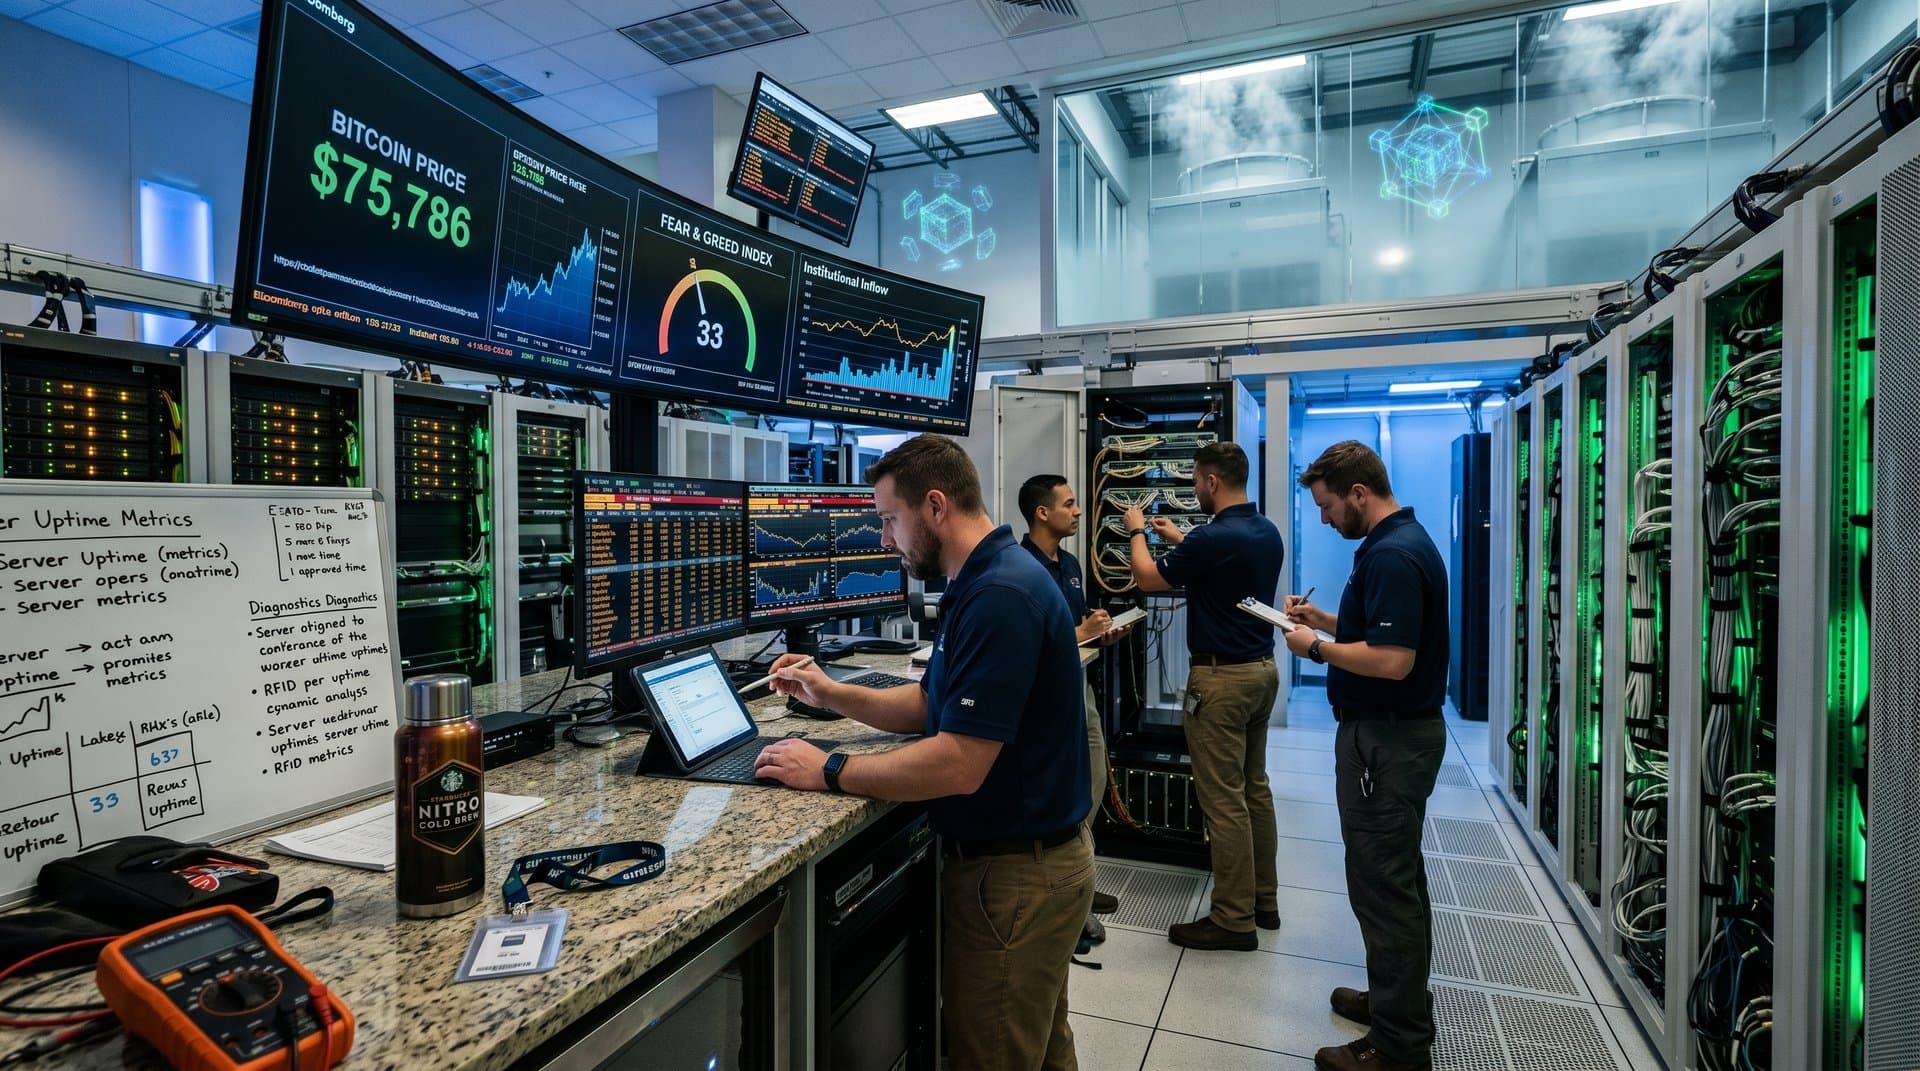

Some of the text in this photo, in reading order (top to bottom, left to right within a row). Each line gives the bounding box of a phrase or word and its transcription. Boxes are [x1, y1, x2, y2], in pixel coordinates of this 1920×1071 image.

[331, 109, 412, 168] BITCOIN
[415, 153, 467, 195] PRICE
[310, 141, 472, 248] $75,786
[660, 213, 773, 267] FEAR & GREED INDEX
[803, 261, 889, 296] Institutional Inflow
[696, 320, 724, 349] 33
[34, 509, 111, 534] Uptime
[121, 509, 193, 527] Metrics
[0, 542, 229, 570] Server Uptime (metrics)
[95, 573, 149, 589] opers
[160, 561, 239, 583] (onatrime)
[298, 564, 342, 578] approved
[345, 562, 367, 572] time
[96, 590, 167, 607] metrics
[248, 592, 378, 616] Diagnostics Diagnostics
[256, 626, 295, 639] Server
[352, 614, 365, 625] to
[332, 633, 344, 645] of
[348, 631, 368, 642] the
[101, 634, 133, 651] act
[0, 651, 172, 692] ptime promites
[106, 668, 167, 688] metrics
[264, 669, 370, 696] RFID per uptime
[268, 718, 316, 737] Server
[362, 719, 390, 732] utime
[10, 747, 64, 768] Uptime
[150, 749, 178, 766] 637
[274, 744, 354, 775] RFID metrics
[89, 793, 119, 813] 33
[419, 796, 479, 819] NITRO
[419, 811, 480, 829] COLD BREW
